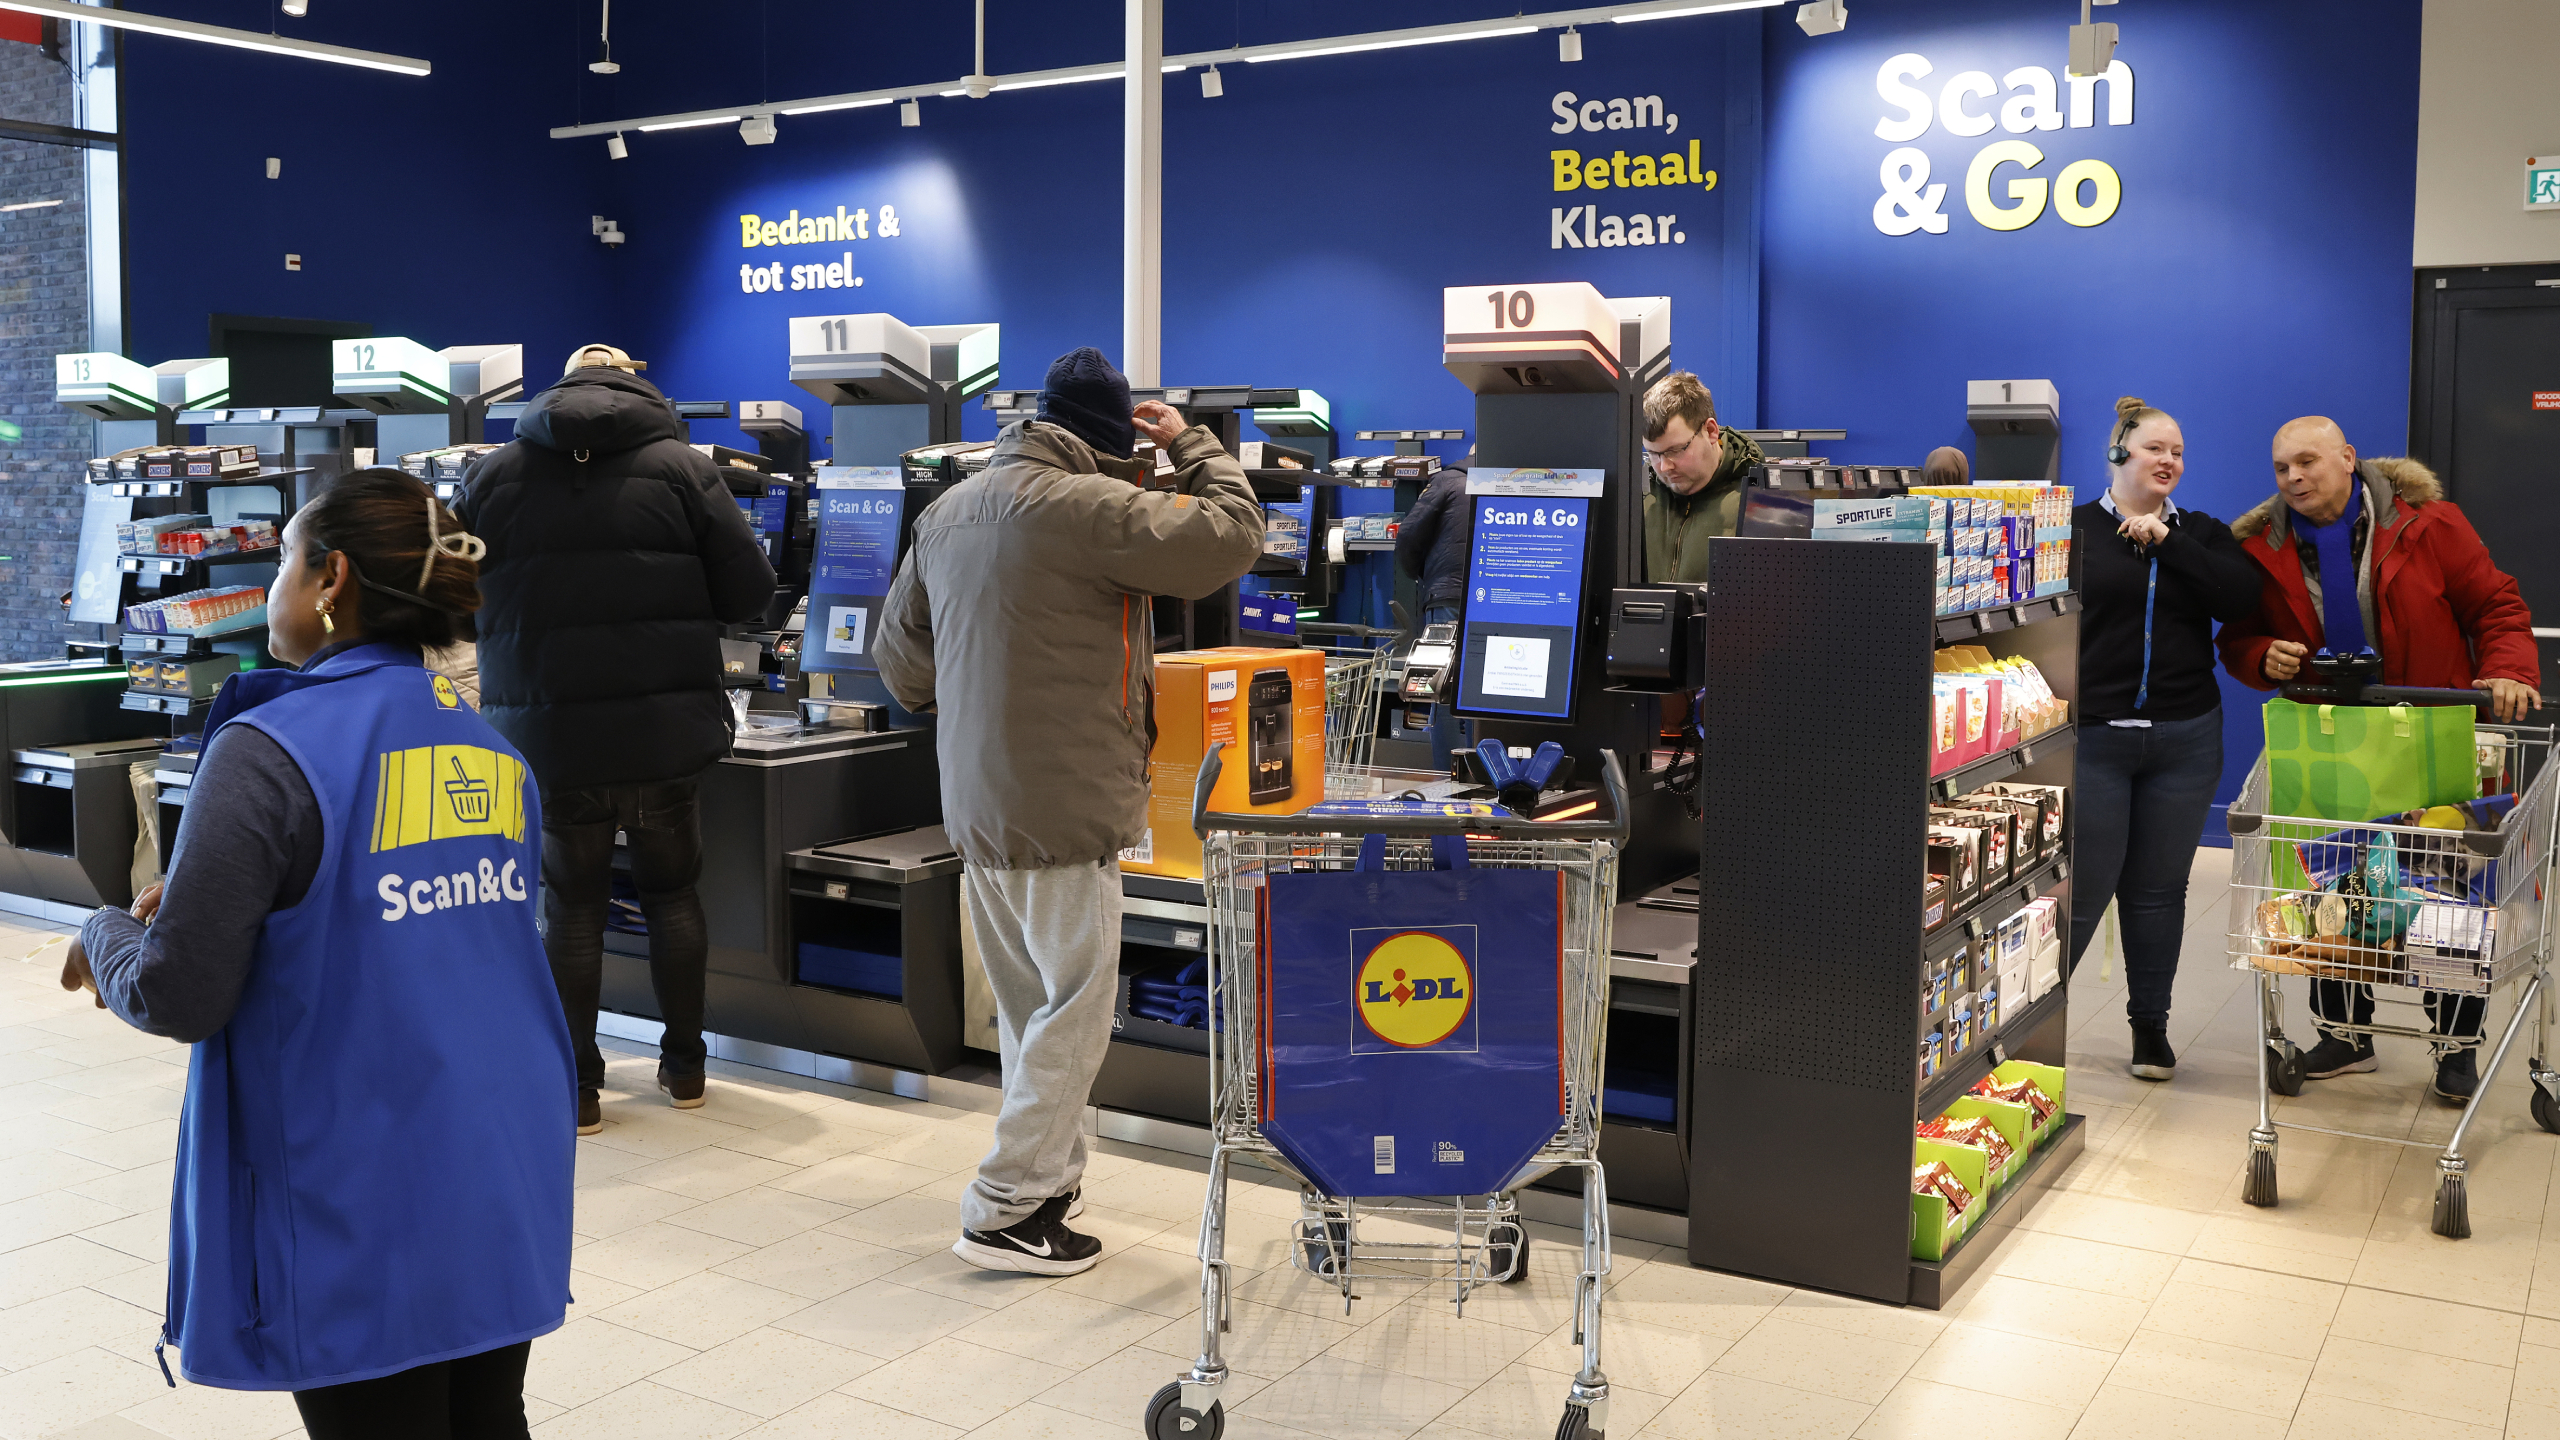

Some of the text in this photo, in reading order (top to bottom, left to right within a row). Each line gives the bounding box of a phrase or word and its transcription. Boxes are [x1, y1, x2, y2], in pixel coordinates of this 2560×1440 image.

[1874, 52, 2134, 142] Scan
[1551, 91, 1679, 135] Scan,
[1551, 139, 1718, 192] Betaal,
[1873, 140, 2122, 237] & Go
[740, 204, 900, 248] Bedankt &
[1551, 204, 1686, 249] Klaar.
[740, 252, 863, 294] tot snel.
[1488, 290, 1534, 329] 10
[820, 319, 847, 353] 11
[353, 345, 375, 371] 12
[74, 358, 90, 381] 13
[2002, 382, 2012, 402] 1
[756, 404, 763, 417] 5
[149, 465, 171, 476] SNICKERS
[188, 463, 212, 475] SNICKERS
[829, 499, 893, 514] Scan & Go
[1484, 508, 1578, 526] Scan & Go
[1836, 506, 1893, 525] SPORTLIFE
[1277, 522, 1297, 530] SPORTLIFE
[1274, 543, 1296, 551] SPORTLIFE
[1211, 681, 1234, 691] PHILIPS
[1439, 1142, 1457, 1150] 90%
